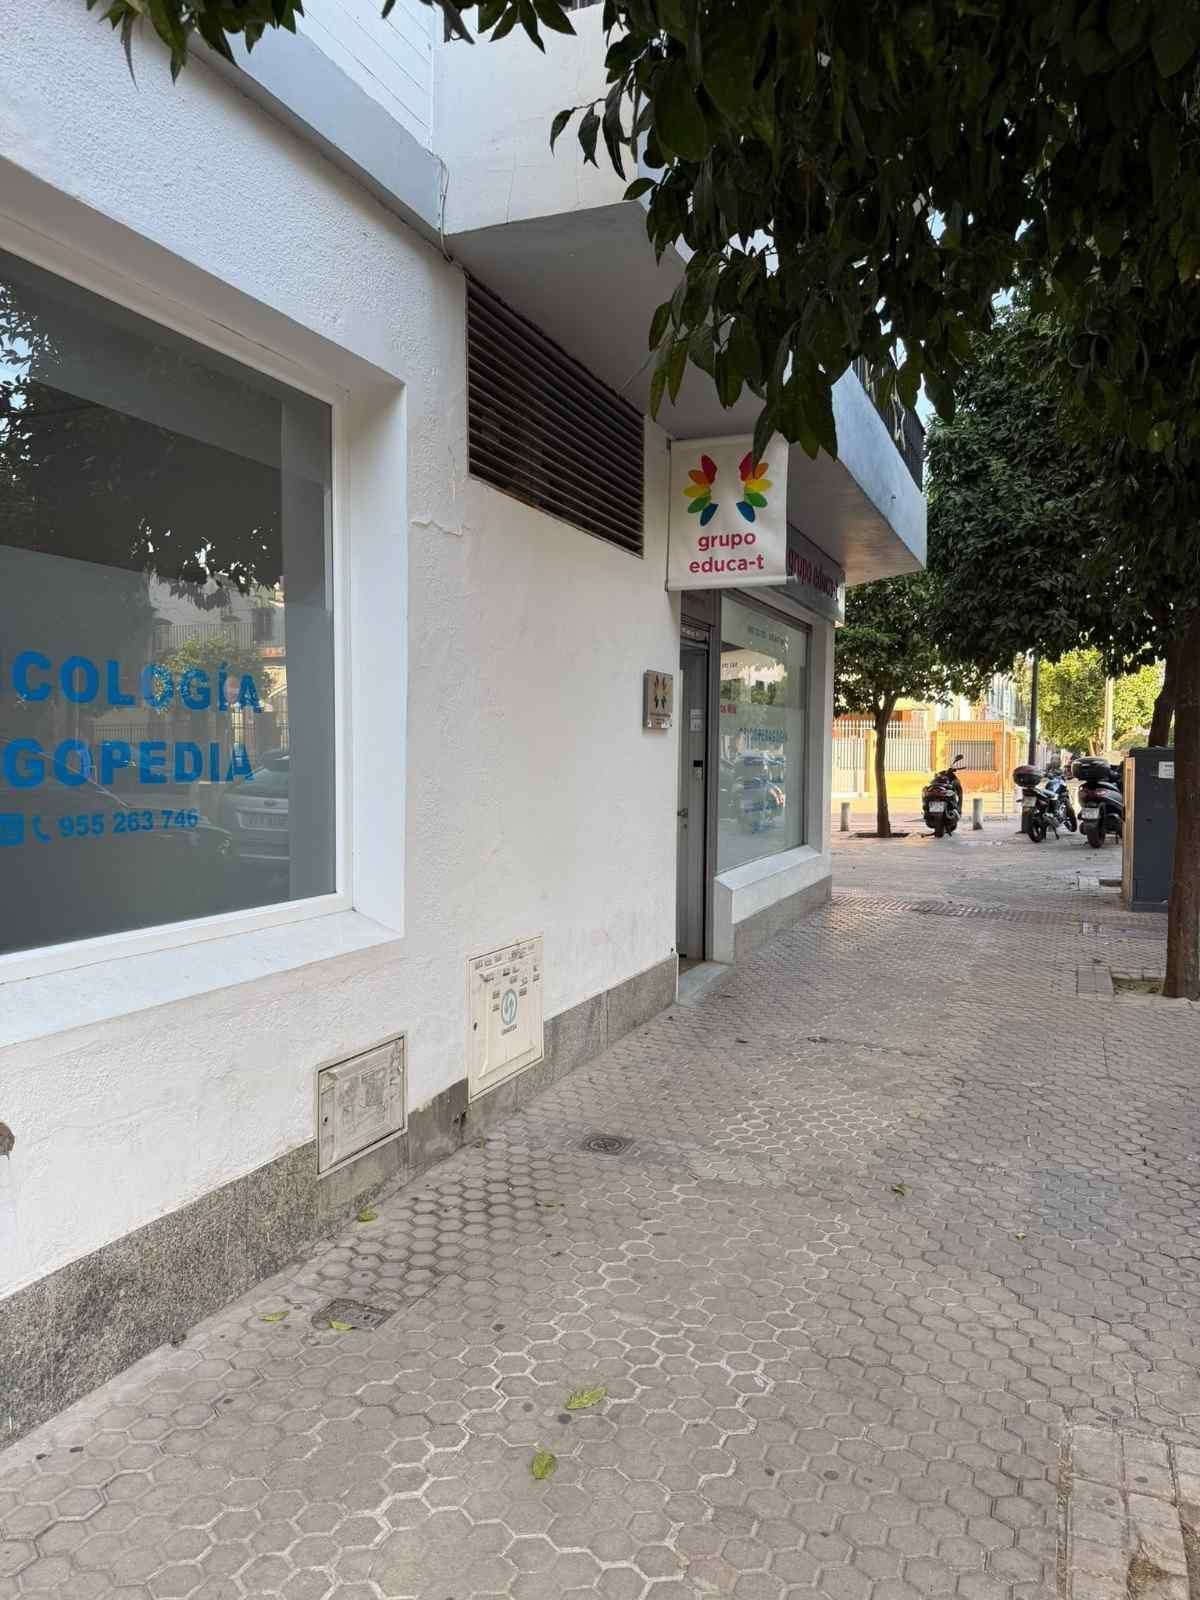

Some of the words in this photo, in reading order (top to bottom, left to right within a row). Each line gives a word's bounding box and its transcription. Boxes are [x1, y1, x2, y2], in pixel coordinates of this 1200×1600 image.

[698, 532, 756, 551] grupo
[689, 554, 764, 573] educa-t
[2, 736, 255, 788] GOPEDIA
[57, 814, 104, 837] 955
[113, 811, 153, 832] 263
[161, 808, 198, 828] 746
